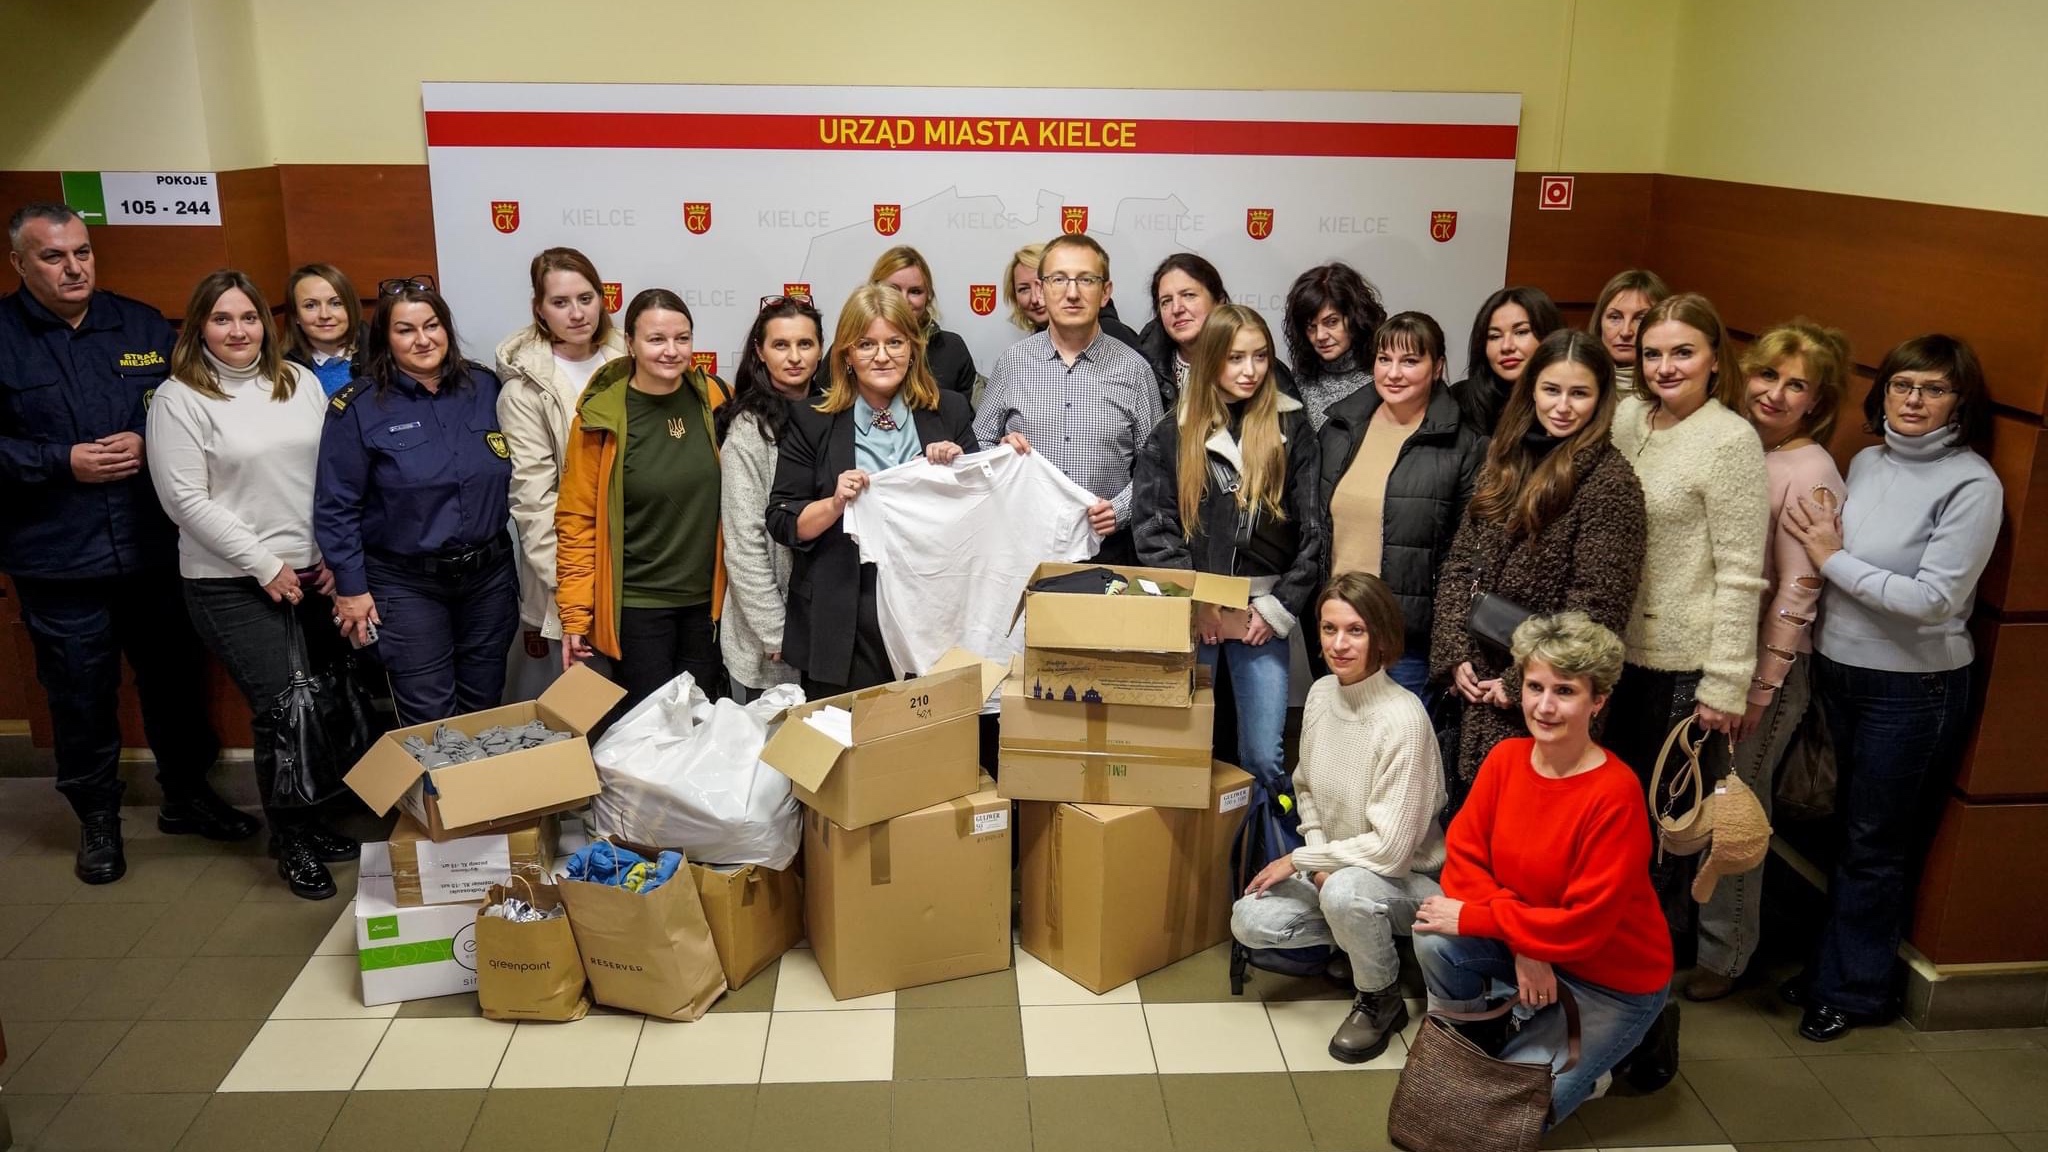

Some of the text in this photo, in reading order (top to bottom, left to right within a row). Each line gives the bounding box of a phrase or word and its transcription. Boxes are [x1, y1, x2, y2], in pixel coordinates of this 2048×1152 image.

[819, 118, 1137, 149] URZĄD MIASTA KIELCE
[156, 175, 208, 186] POKOJE
[120, 200, 156, 215] 105
[175, 200, 211, 215] 244
[495, 214, 515, 230] CK
[562, 208, 636, 228] KIELCE
[687, 215, 706, 231] CK
[757, 209, 831, 229] KIELCE
[876, 217, 895, 233] CK
[946, 212, 1018, 231] KIELCE
[1133, 213, 1205, 232] KIELCE
[1318, 216, 1391, 234] KIELCE
[1064, 218, 1082, 235] CK
[1249, 220, 1267, 237] CK
[1432, 223, 1450, 239] CK
[972, 297, 989, 312] CK
[120, 356, 165, 367] MIEJSKA
[123, 351, 157, 361] STRAŻ
[910, 694, 929, 709] 210
[488, 959, 551, 973] greenpoint
[590, 957, 643, 972] RESERVED
